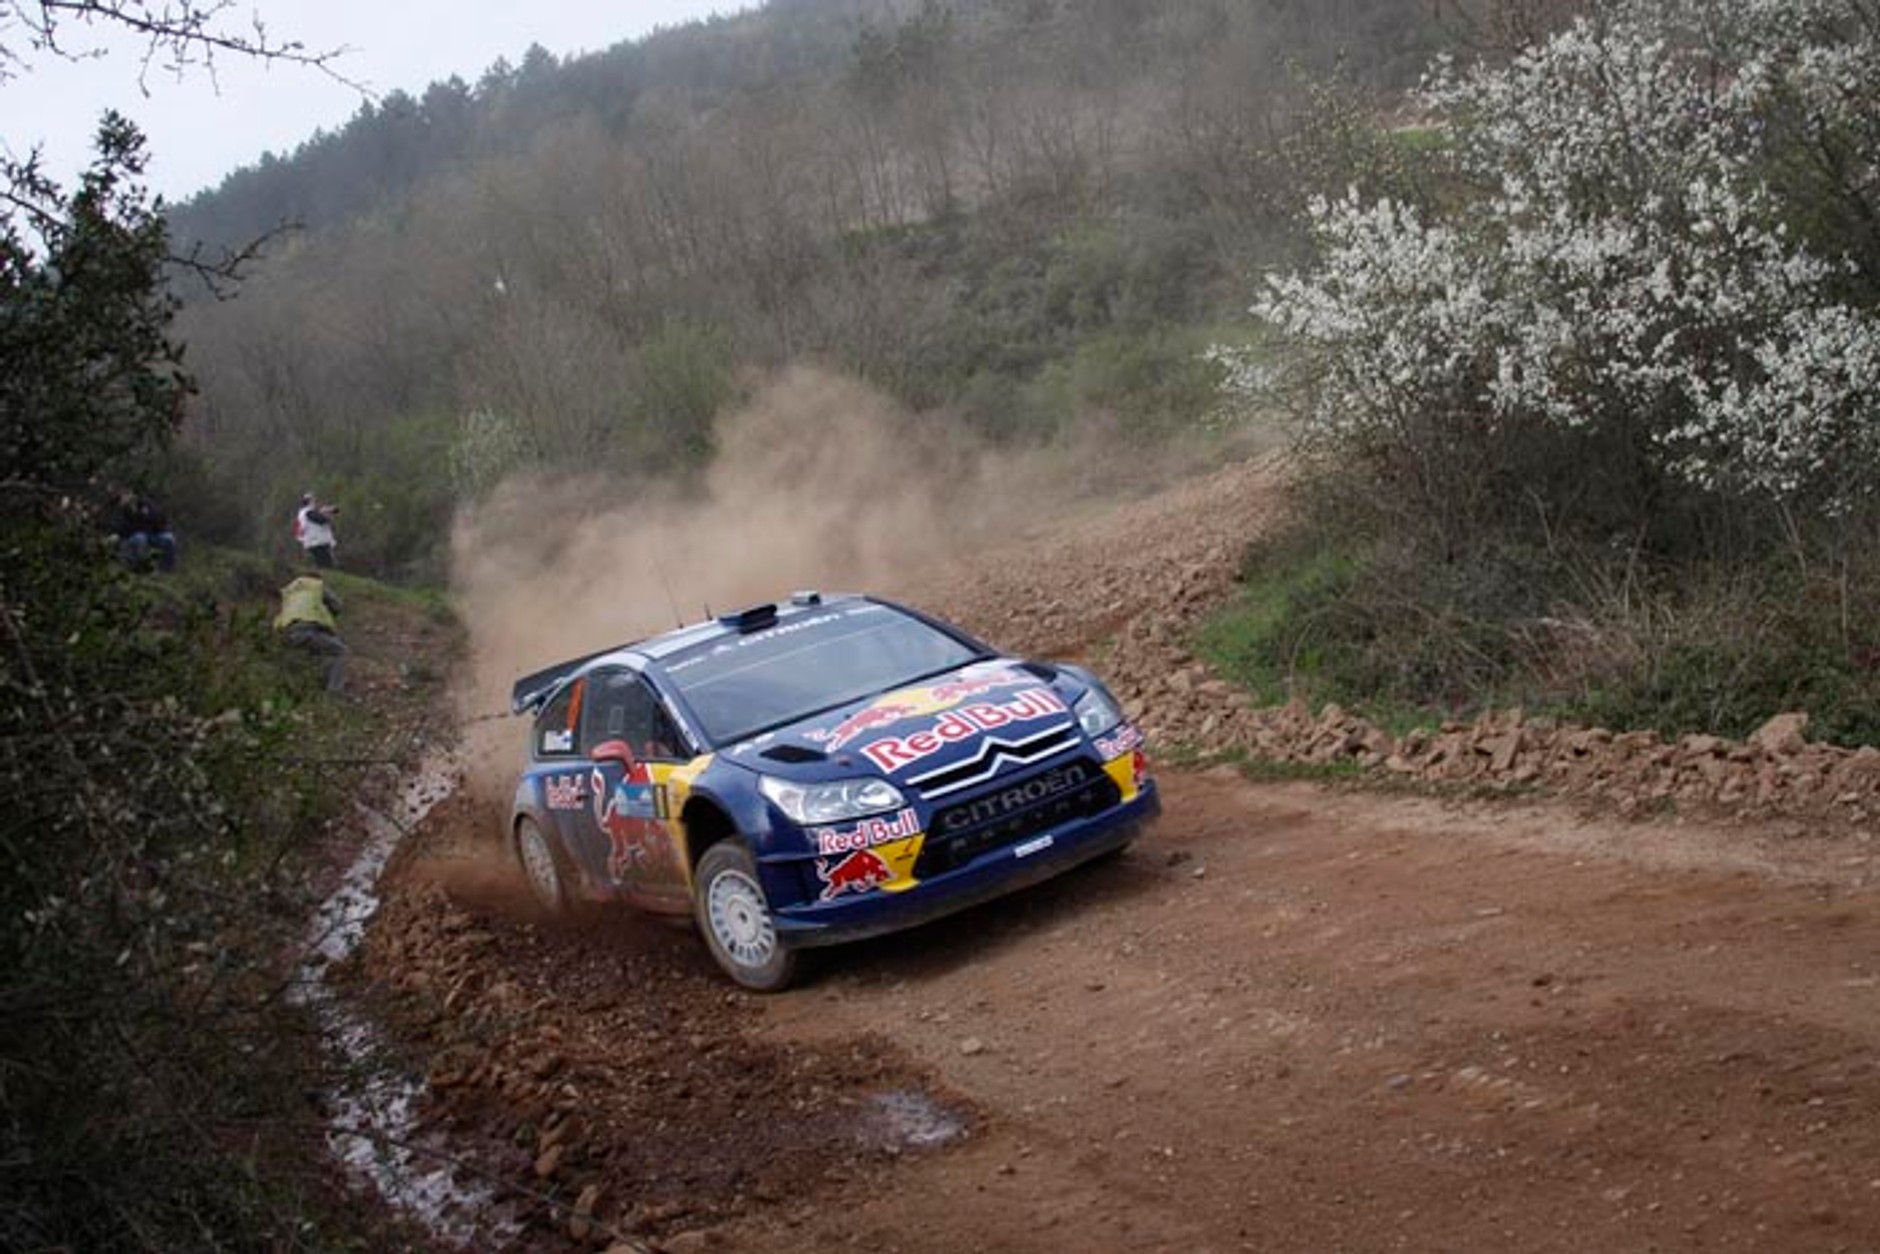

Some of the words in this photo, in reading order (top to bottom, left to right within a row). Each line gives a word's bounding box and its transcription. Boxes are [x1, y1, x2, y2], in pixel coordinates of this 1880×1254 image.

[862, 712, 976, 772] Red
[961, 688, 1067, 730] Bull
[820, 821, 868, 854] Red
[869, 809, 919, 843] Bull
